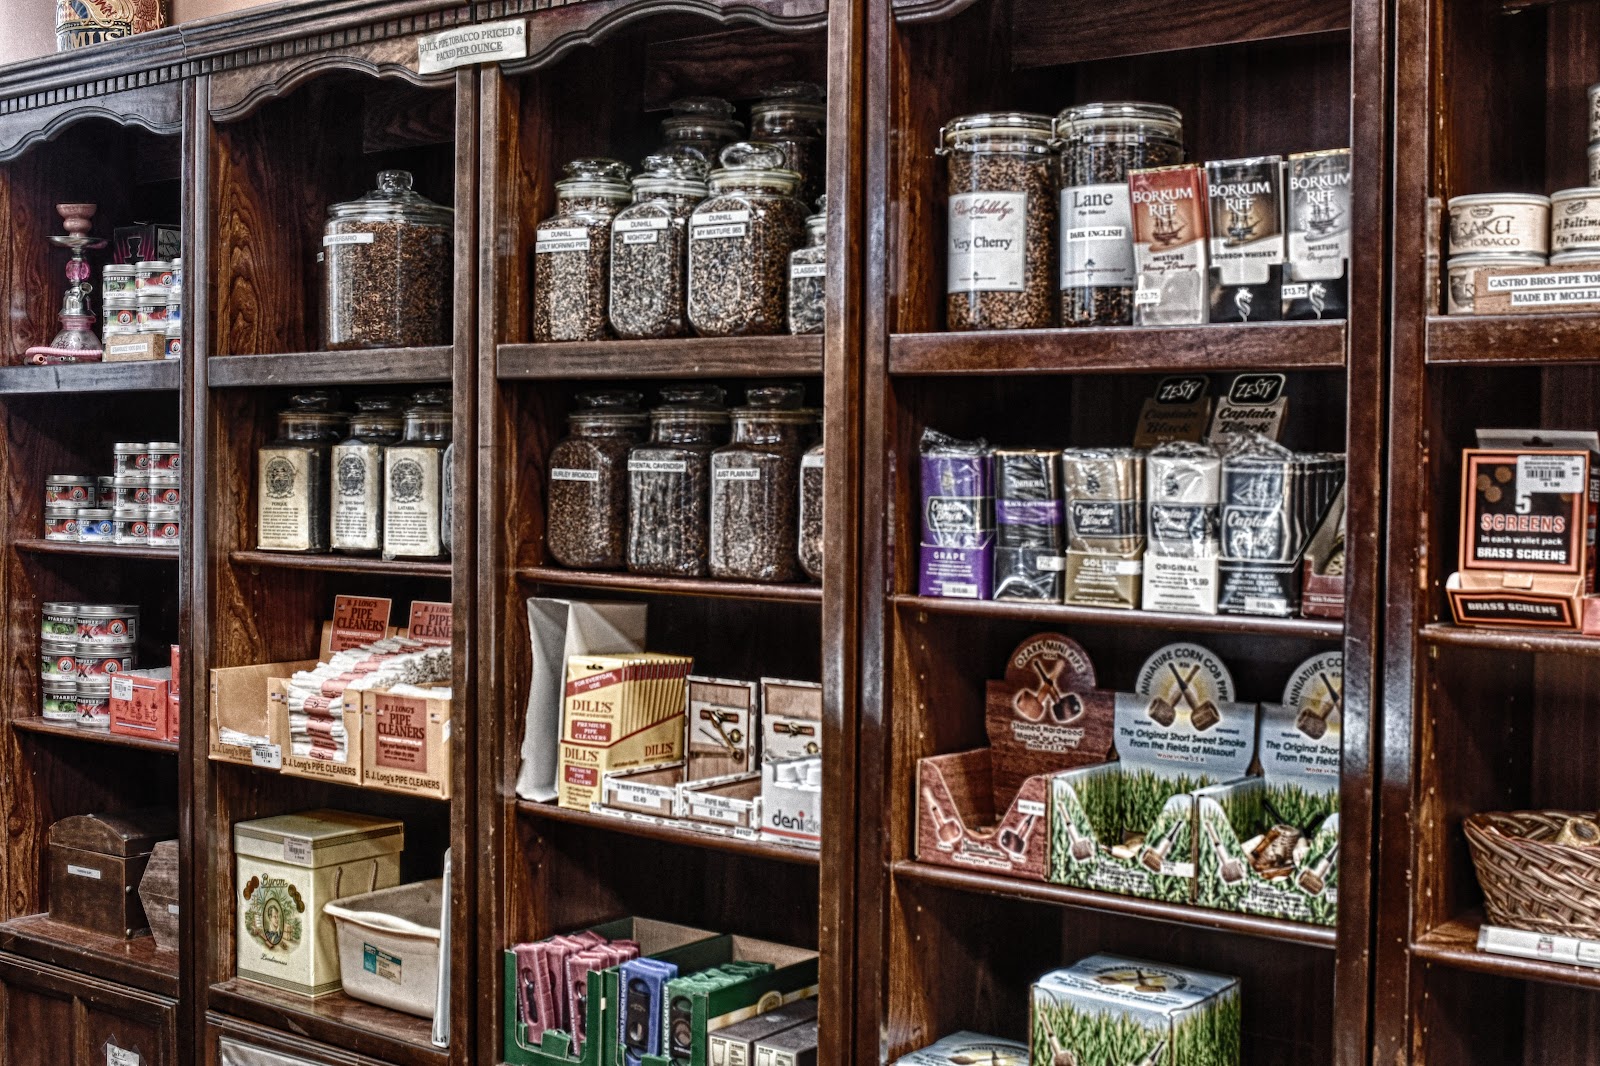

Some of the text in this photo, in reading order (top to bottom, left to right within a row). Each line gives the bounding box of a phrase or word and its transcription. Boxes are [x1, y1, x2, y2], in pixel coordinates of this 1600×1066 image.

[420, 25, 523, 53] BULK PIPE TOBACCO PRICED &
[436, 41, 503, 62] PACKED PER OUNCE
[1291, 172, 1350, 190] BORKUM
[1132, 187, 1192, 205] BORKUM
[1209, 181, 1270, 199] BORKUM
[1307, 190, 1335, 204] RIFF
[1073, 191, 1113, 208] Lane
[1225, 199, 1254, 214] RIFF
[1150, 203, 1178, 218] RIFF
[707, 228, 731, 236] MIXTURE
[1459, 215, 1515, 236] RAKU
[1088, 229, 1122, 238] ENGLISH
[953, 236, 1012, 251] Very Cherry
[1308, 243, 1339, 251] MIXTURE
[1245, 250, 1278, 258] WHISKEY
[1490, 275, 1581, 288] CASTRO BROS PIPE
[1513, 292, 1557, 302] MADE BY
[1160, 380, 1201, 400] ZESTY
[1235, 379, 1277, 399] ZESTY
[1218, 407, 1277, 420] Captain
[1515, 492, 1532, 514] 5
[1481, 513, 1565, 533] SCREENS
[1481, 535, 1563, 547] in each wallet pack
[933, 551, 965, 561] GRAPE
[1477, 547, 1566, 560] BRASS SCREENS
[1083, 558, 1103, 567] GOL
[1155, 563, 1199, 572] ORIGINAL
[351, 607, 373, 620] PIPE
[1467, 602, 1557, 614] BRASS SCREENS
[336, 617, 384, 632] CLEANERS
[428, 614, 452, 626] PIPE
[1017, 641, 1084, 672] OZARK MINI PIPE
[586, 672, 613, 684] EVERYDAY
[1141, 648, 1228, 701] MINIATURE CORN COB PIPE
[1289, 660, 1325, 707] MINIATURE
[572, 700, 612, 713] DILL'S
[390, 713, 411, 726] PIPE
[377, 722, 425, 740] CLEANERS
[1013, 723, 1083, 736] Stained Hardwood
[575, 733, 606, 742] CLEANERS
[1016, 732, 1040, 742] Maple
[1052, 736, 1078, 745] Cherry
[1120, 727, 1247, 748] The Original Short Sweet Smoke
[645, 742, 674, 757] DILL'S
[1129, 740, 1236, 757] From the Fields of Missouri
[1266, 740, 1281, 750] The
[1283, 741, 1318, 753] Original
[565, 747, 598, 762] DILL'S
[1276, 752, 1314, 763] From the
[283, 757, 356, 776] B. J. Long's PIPE CLEANERS
[365, 770, 440, 790] B. J. Long's PIPE CLEANERS
[633, 786, 646, 794] PIPE
[705, 798, 730, 809] PIPE NAIL
[261, 873, 288, 888] Byron
